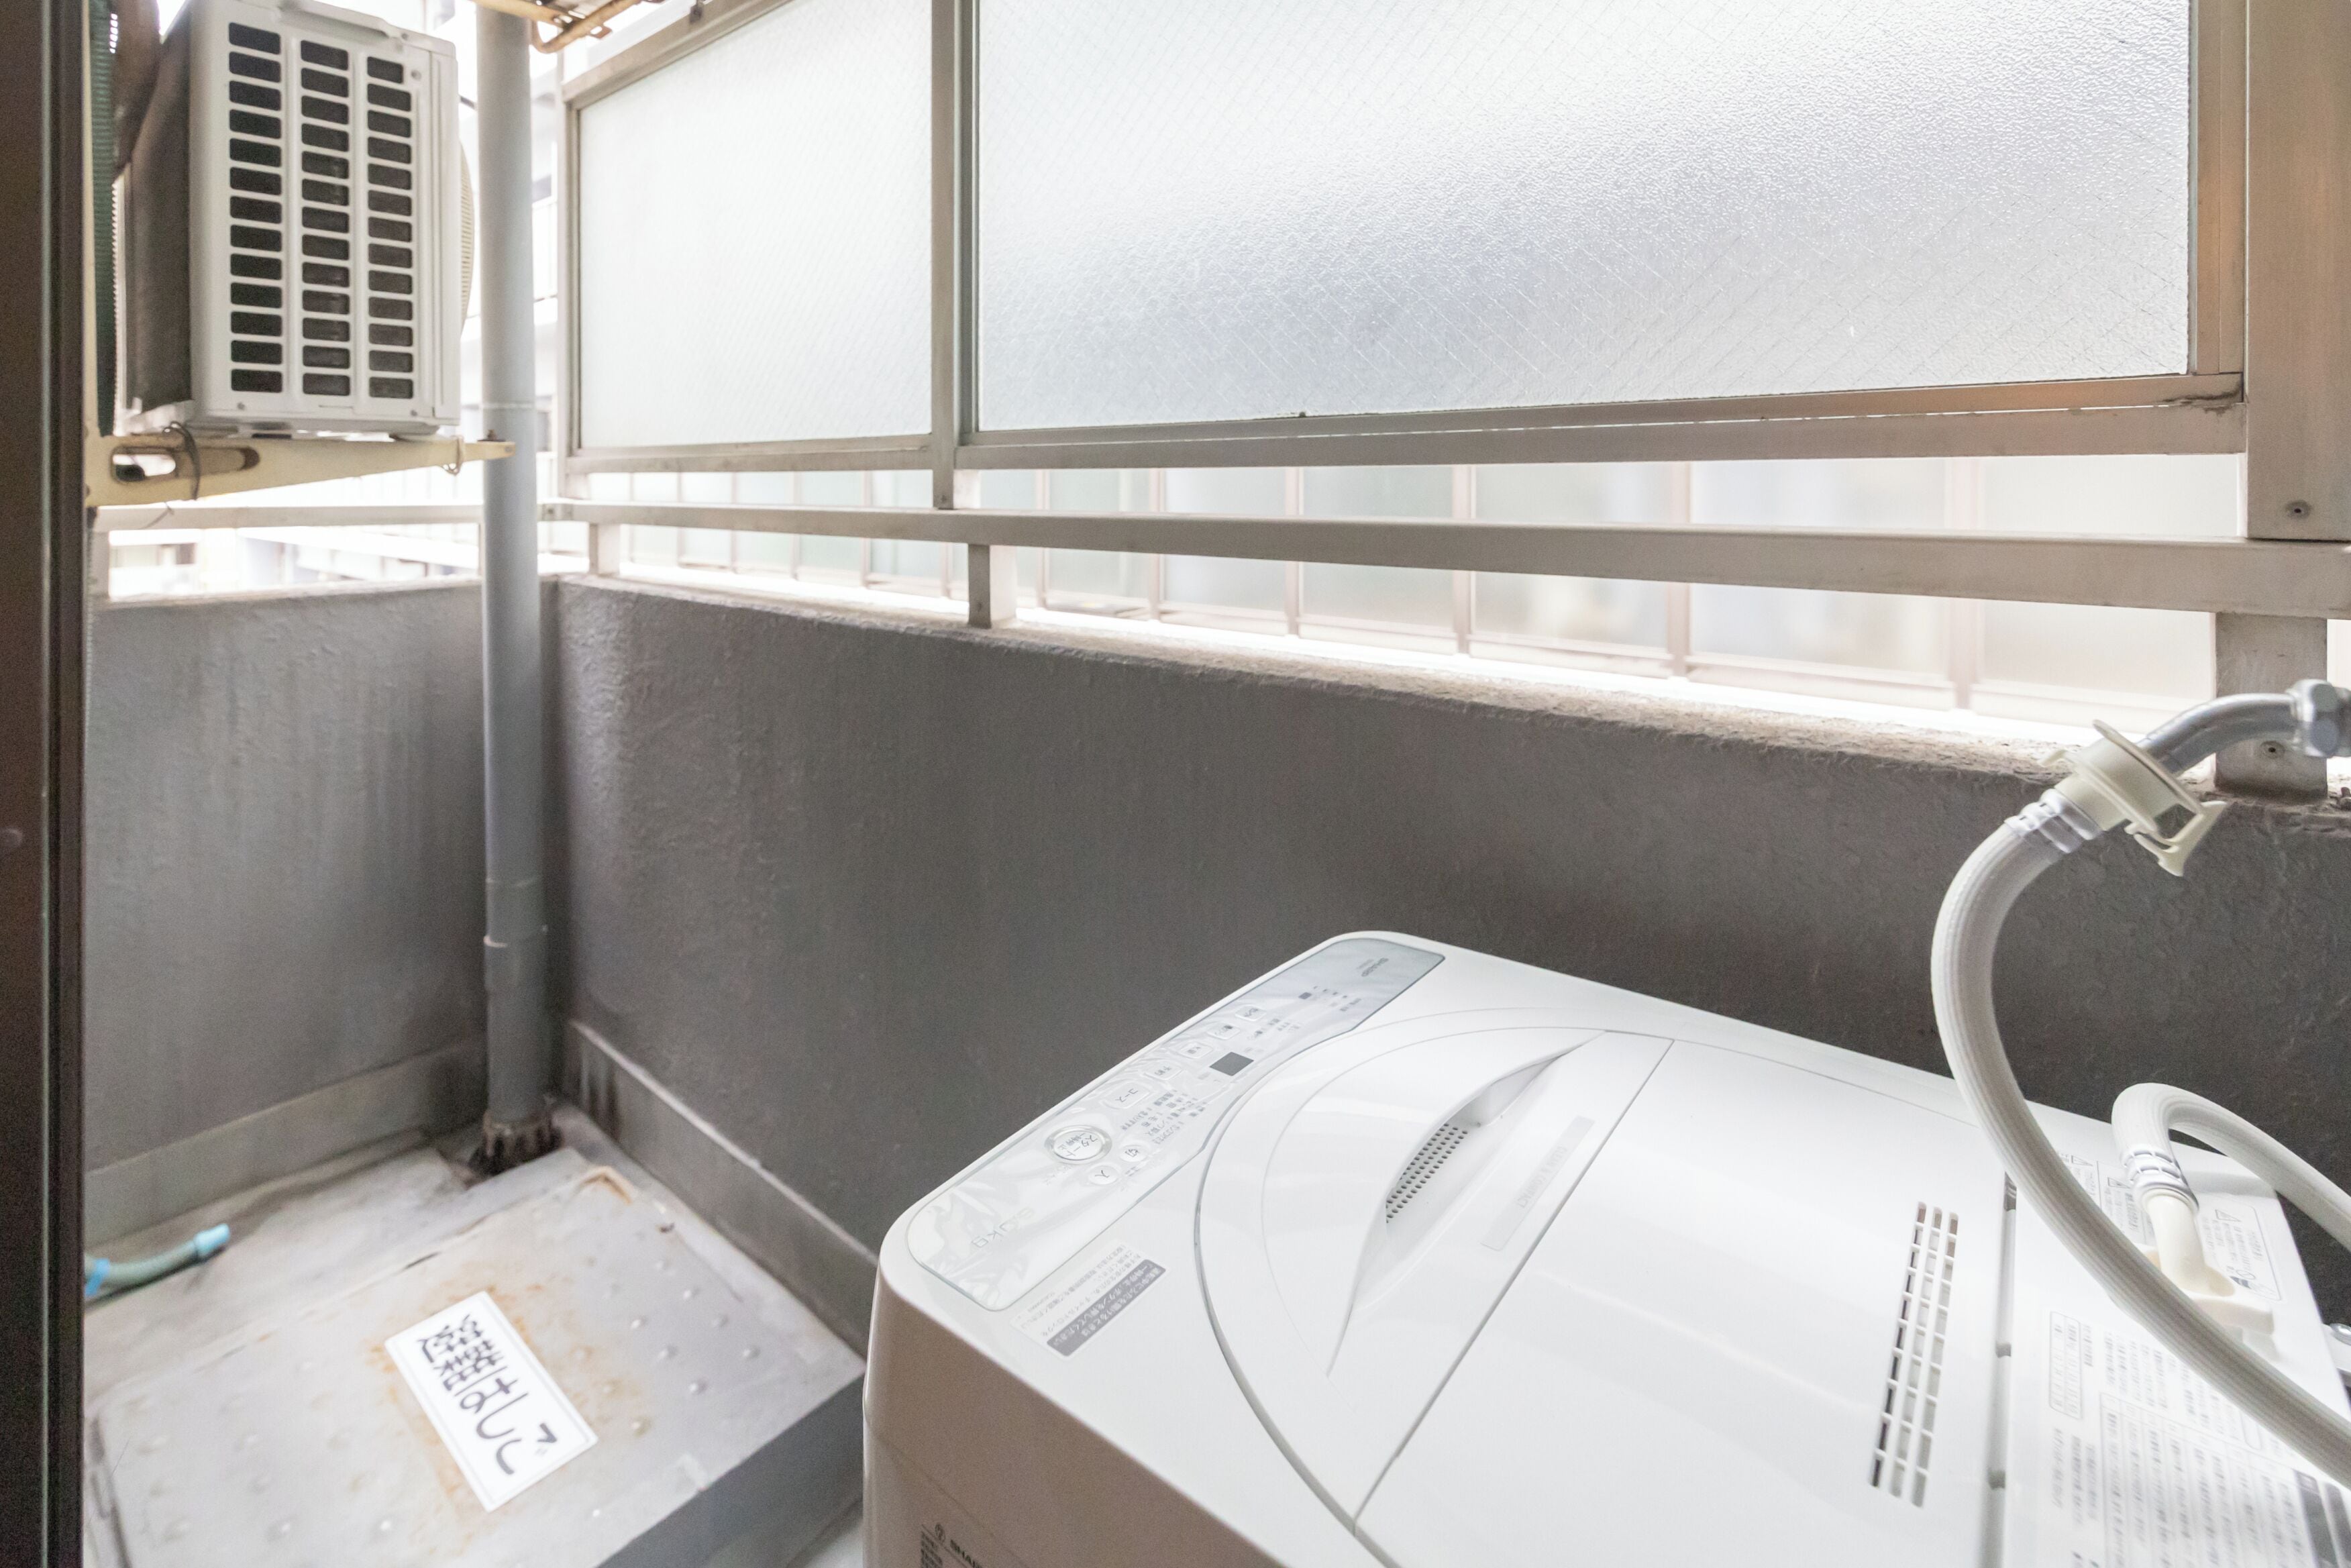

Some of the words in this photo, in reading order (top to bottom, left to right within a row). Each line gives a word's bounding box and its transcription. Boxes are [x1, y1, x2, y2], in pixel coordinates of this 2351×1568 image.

[1155, 1065, 1171, 1076] 予約
[1115, 1088, 1138, 1102] コース
[1141, 1116, 1157, 1127] 毛布
[1057, 1133, 1085, 1150] 一時停止
[1065, 1135, 1098, 1157] スタート
[1125, 1148, 1139, 1157] 切
[1095, 1170, 1110, 1178] 入
[417, 1313, 559, 1475] 避難はしご
